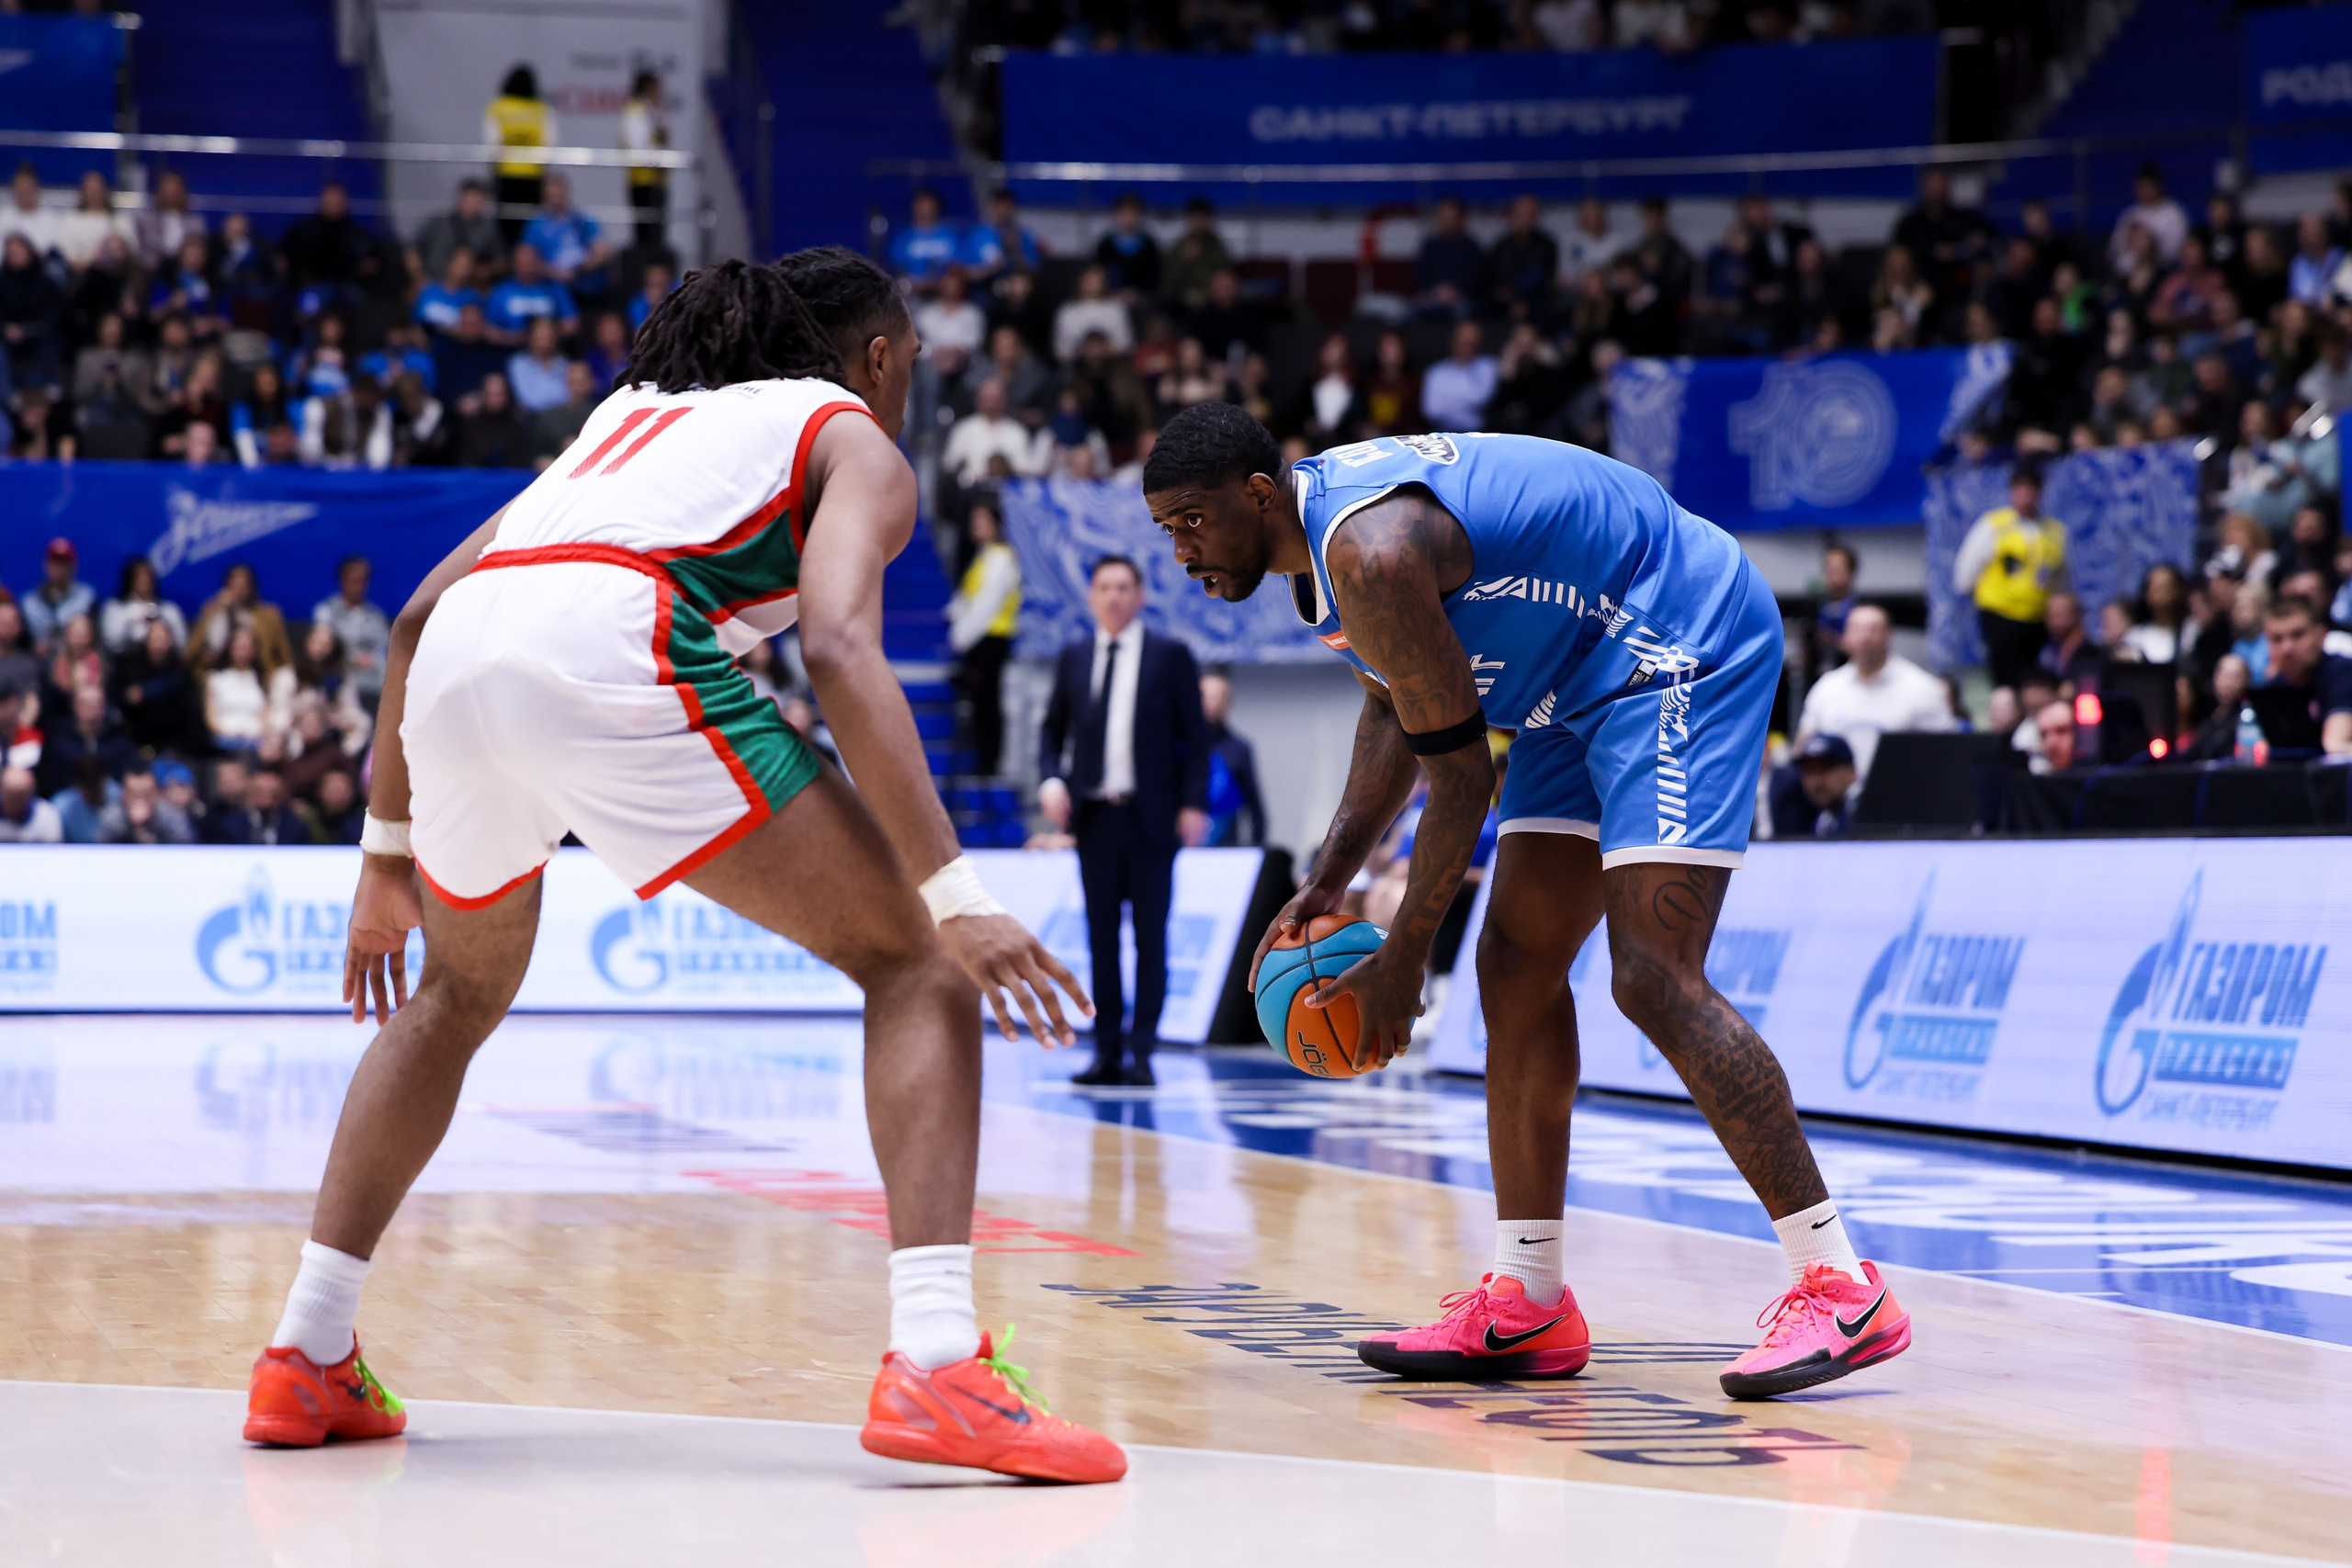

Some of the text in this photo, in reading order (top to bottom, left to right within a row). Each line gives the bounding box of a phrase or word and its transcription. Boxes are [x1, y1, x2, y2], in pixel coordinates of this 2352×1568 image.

[1250, 98, 1689, 141] САНКТ-ПЕТЕРБУРГ
[567, 407, 695, 479] 11
[1905, 935, 2026, 1009] ГАЗПРОМ
[2171, 943, 2327, 1028] ГАЗПРОМ
